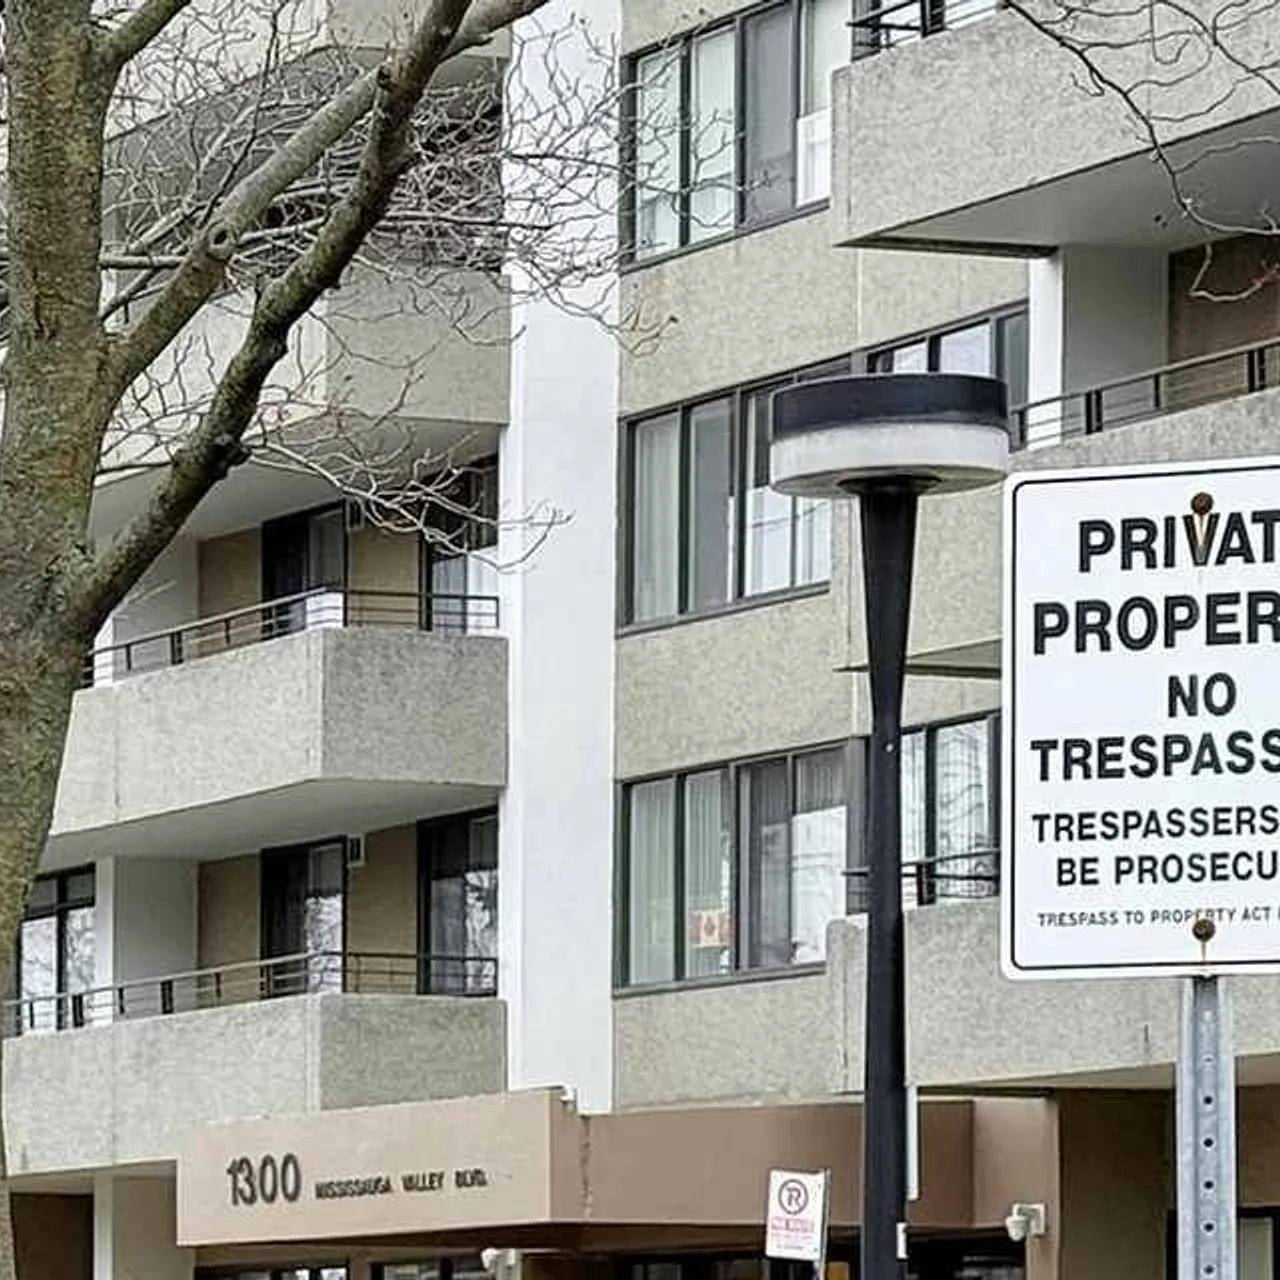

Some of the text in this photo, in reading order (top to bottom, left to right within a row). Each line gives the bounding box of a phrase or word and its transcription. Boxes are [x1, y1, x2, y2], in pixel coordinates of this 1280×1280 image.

[1079, 508, 1280, 573] PRIVAT
[1033, 590, 1280, 656] PROPER
[1167, 671, 1237, 719] NO
[1029, 727, 1280, 782] TRESPASS
[1031, 804, 1280, 844] TRESPASSERS
[1056, 850, 1279, 887] BE PROSECU
[1038, 910, 1120, 927] TRESPASS
[1125, 910, 1145, 924] TO
[1242, 905, 1272, 921] ACT
[226, 1153, 302, 1206] 1300
[402, 1171, 445, 1192] VALLEY
